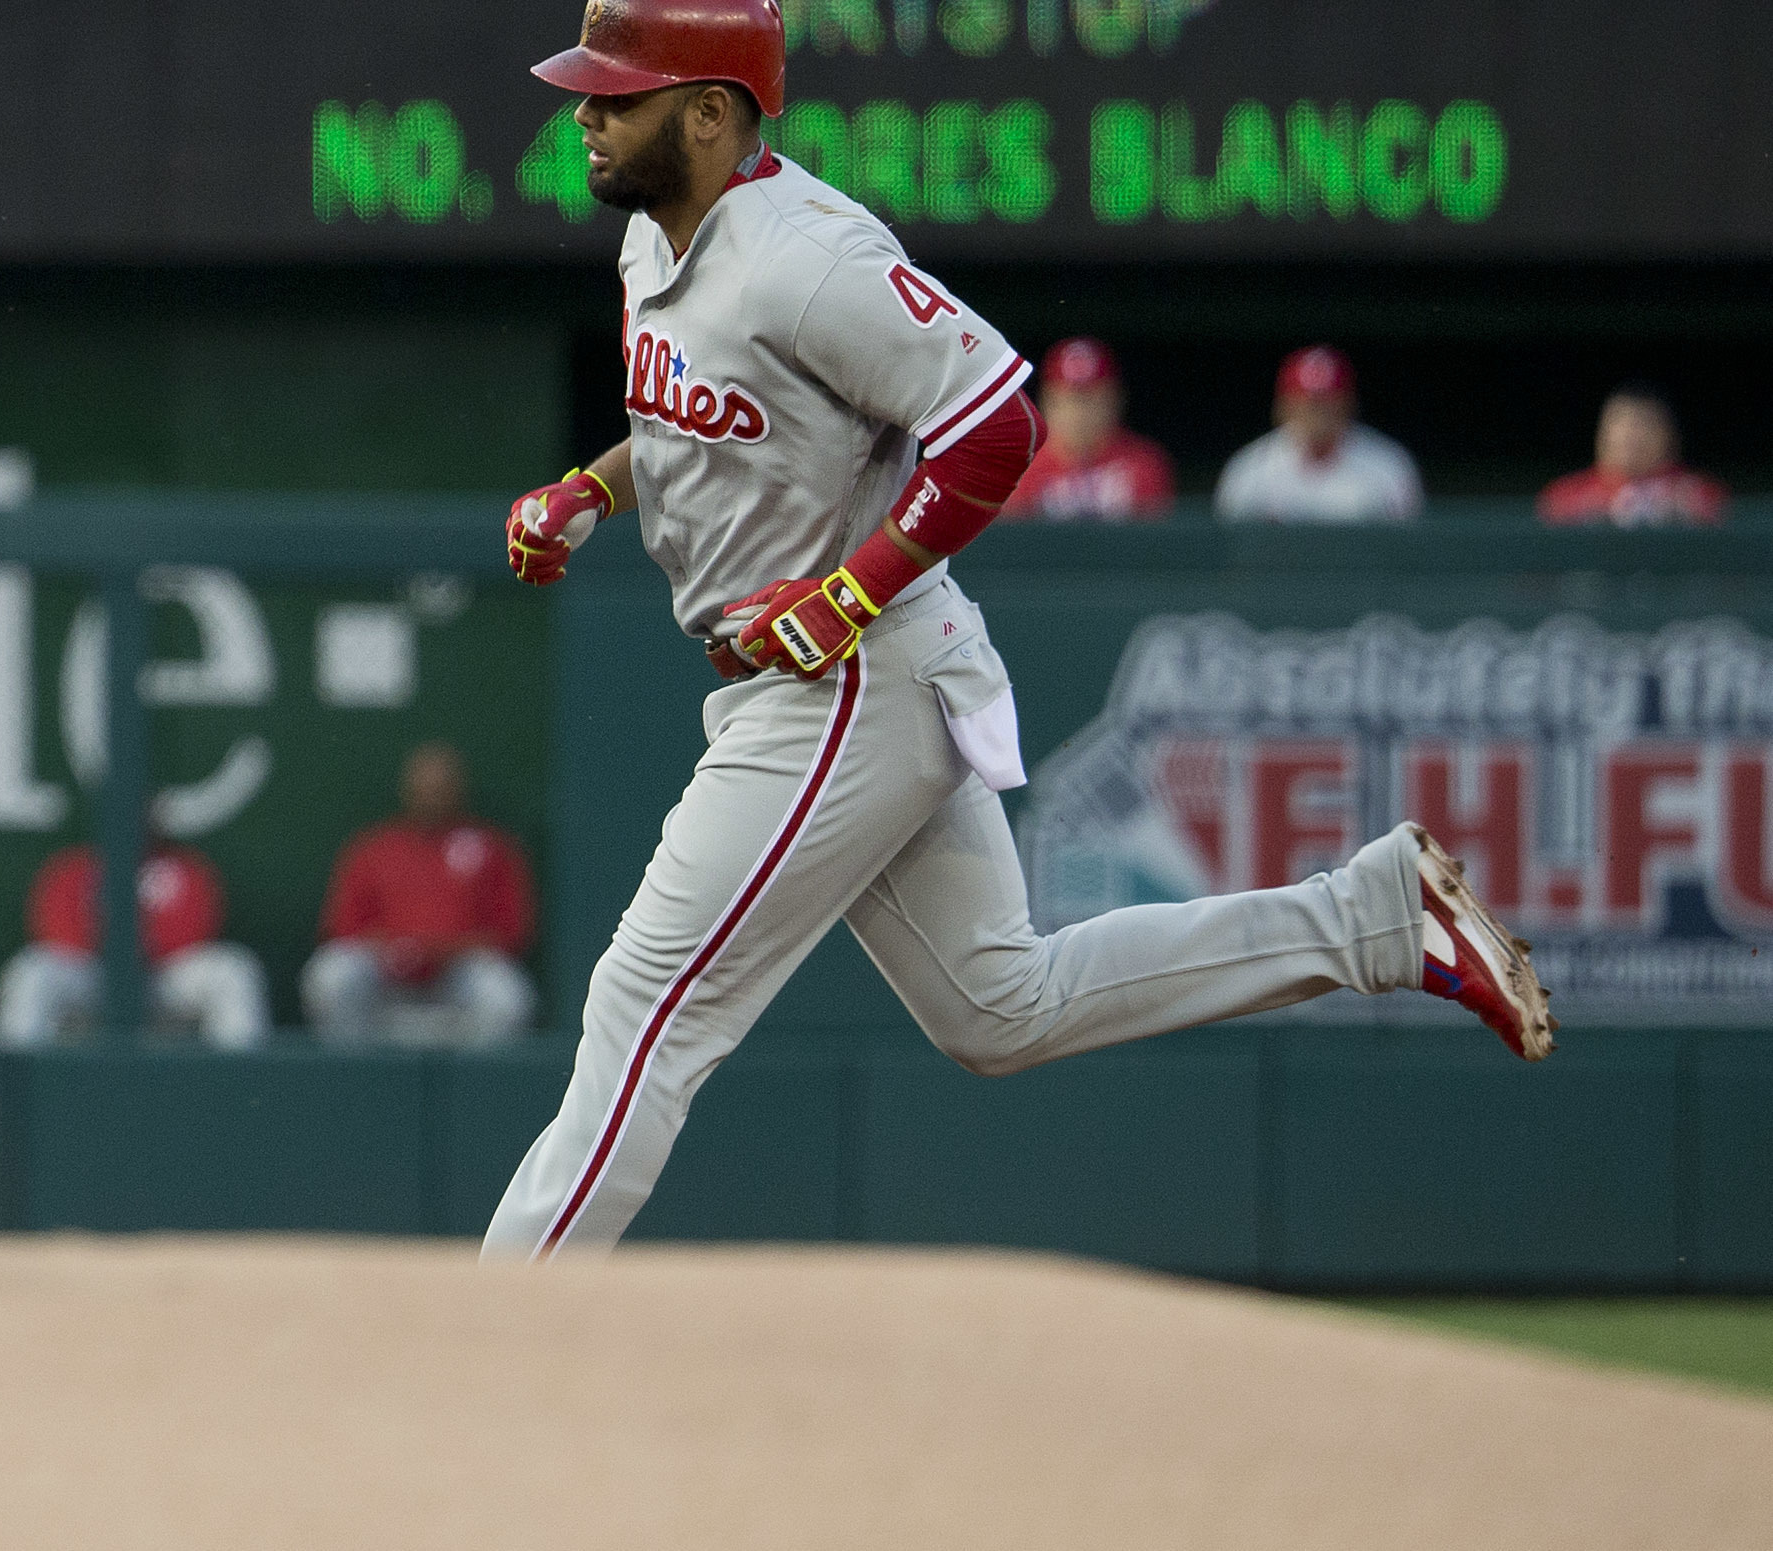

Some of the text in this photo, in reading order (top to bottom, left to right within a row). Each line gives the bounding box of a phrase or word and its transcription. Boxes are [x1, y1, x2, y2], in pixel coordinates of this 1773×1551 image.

[312, 99, 495, 225] NO.
[761, 98, 1060, 225] DRES
[1089, 98, 1509, 225] BLANCO
[885, 259, 962, 328] 4
[622, 308, 769, 442] llies
[778, 616, 823, 665] Franklin
